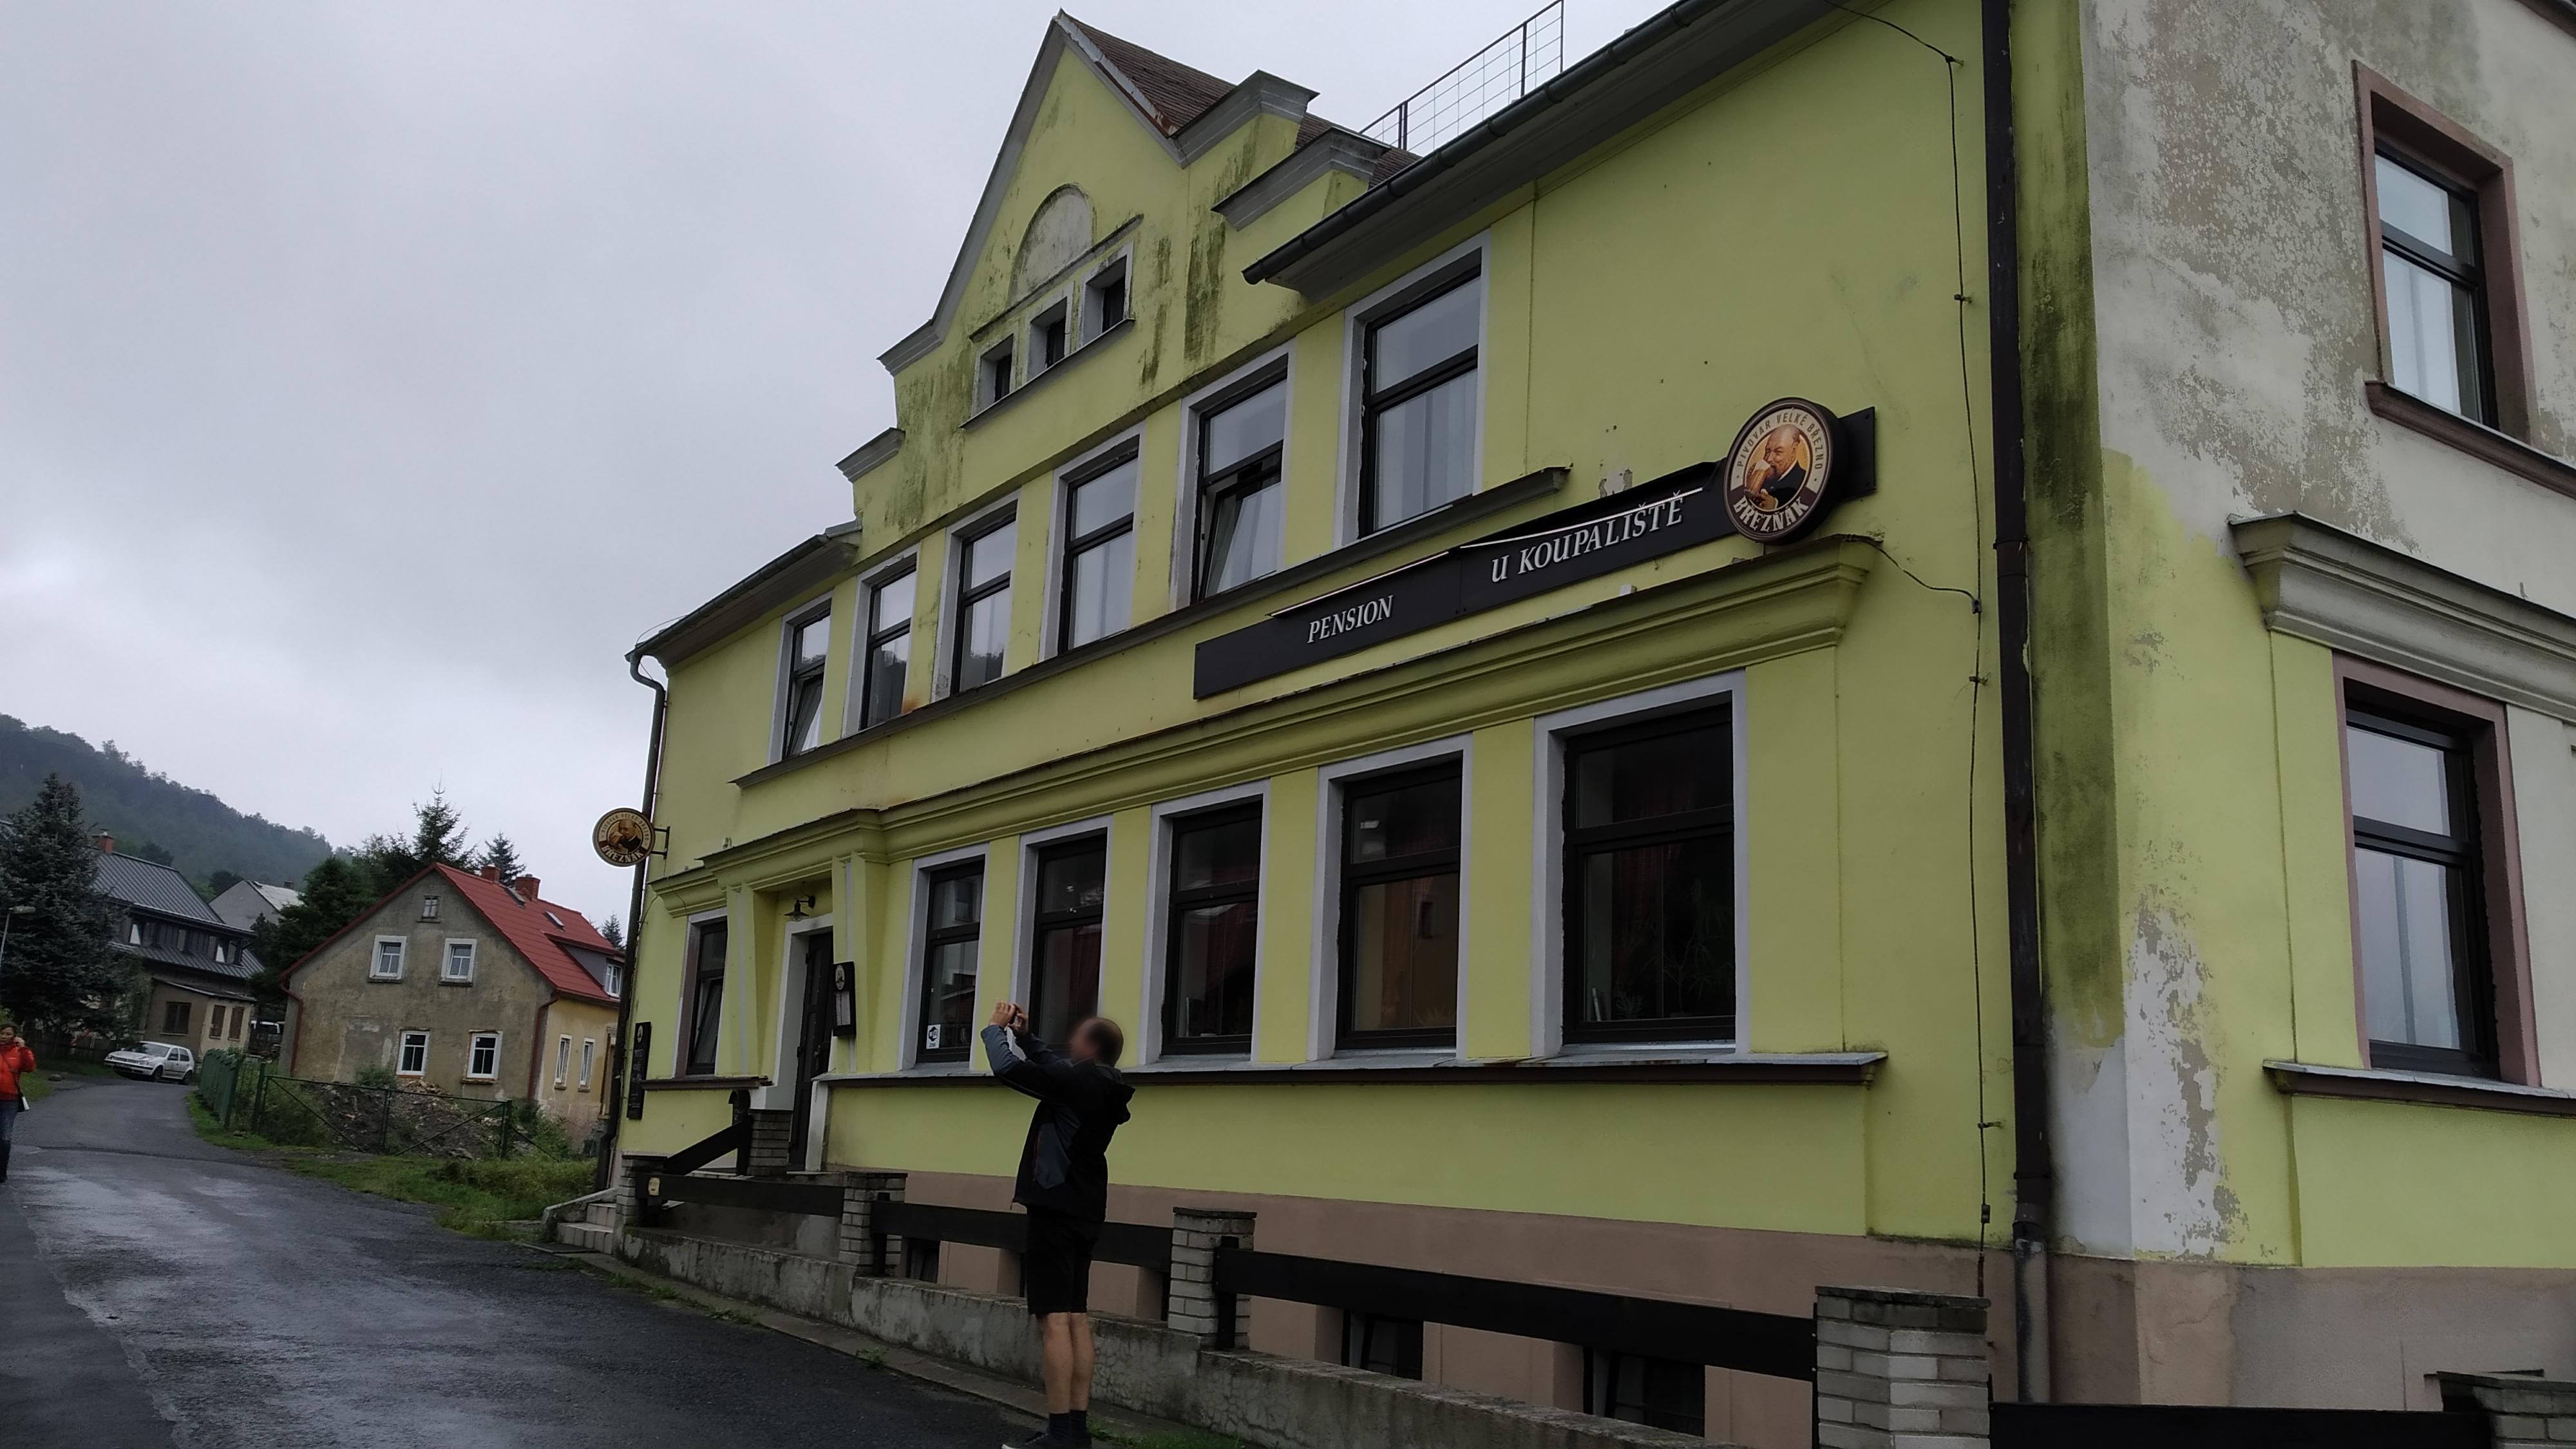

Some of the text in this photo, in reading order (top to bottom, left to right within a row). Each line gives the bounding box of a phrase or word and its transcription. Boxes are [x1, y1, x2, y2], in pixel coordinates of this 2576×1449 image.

[1737, 412, 1823, 469] PIVOVAR VELKÉ BŘEZNO
[1733, 496, 1809, 533] BŘEZŇÁK
[1307, 490, 1684, 643] PENSION U KOUPALIŠTĚ
